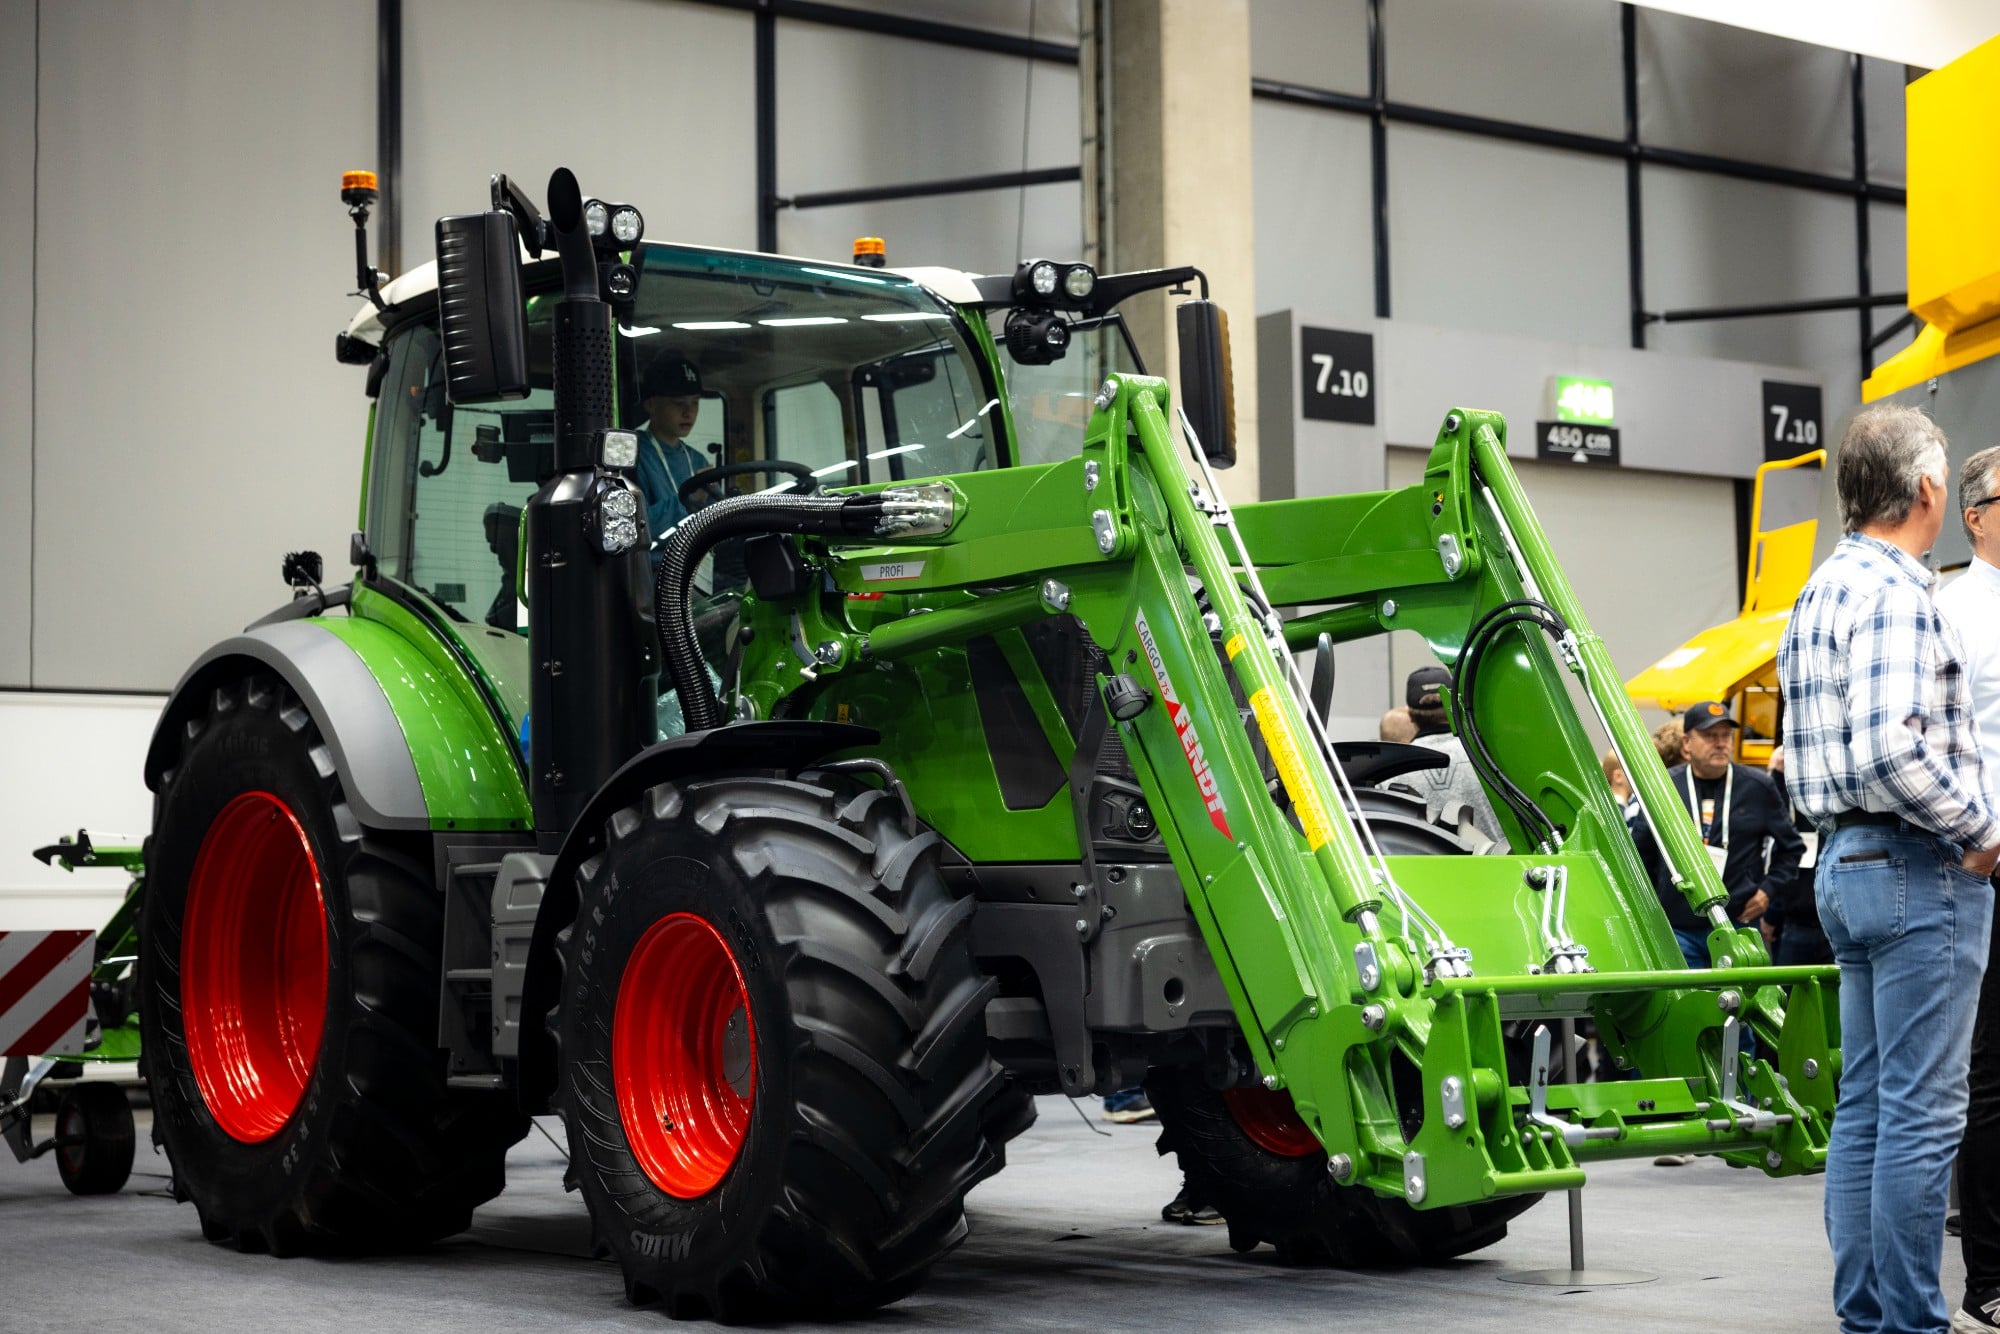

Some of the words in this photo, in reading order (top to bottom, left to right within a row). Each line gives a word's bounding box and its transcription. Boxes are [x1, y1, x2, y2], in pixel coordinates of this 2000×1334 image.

[1311, 353, 1369, 398] 7.10
[1547, 425, 1583, 449] 450
[1585, 432, 1612, 450] cm
[1770, 404, 1818, 445] 7.10
[880, 565, 904, 578] PROFI
[1137, 620, 1161, 670] CARGO
[1173, 702, 1228, 813] FENDT
[630, 1226, 699, 1263] Mitas
